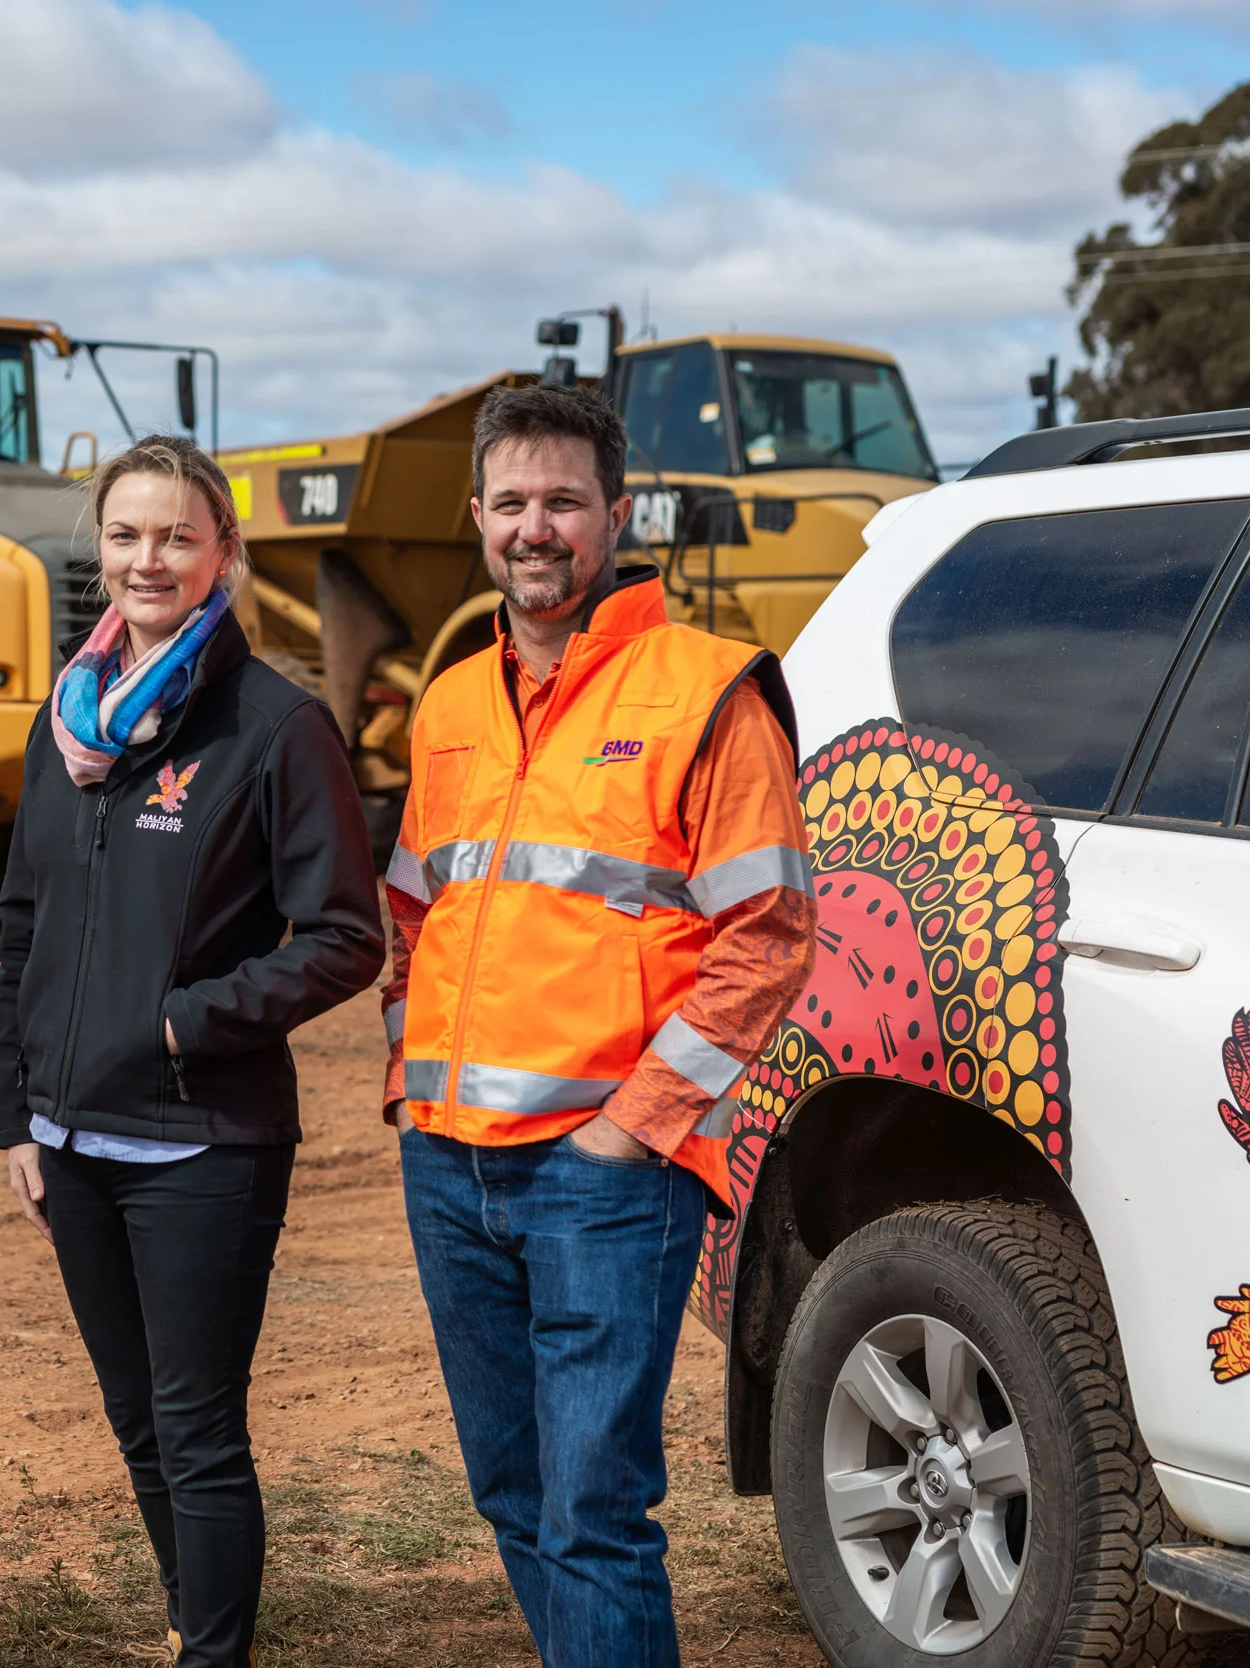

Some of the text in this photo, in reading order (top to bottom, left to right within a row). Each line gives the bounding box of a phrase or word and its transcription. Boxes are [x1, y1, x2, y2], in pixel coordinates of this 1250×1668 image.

[299, 473, 338, 517] 740
[139, 812, 182, 825] MALIYAN
[135, 821, 181, 834] HORIZON
